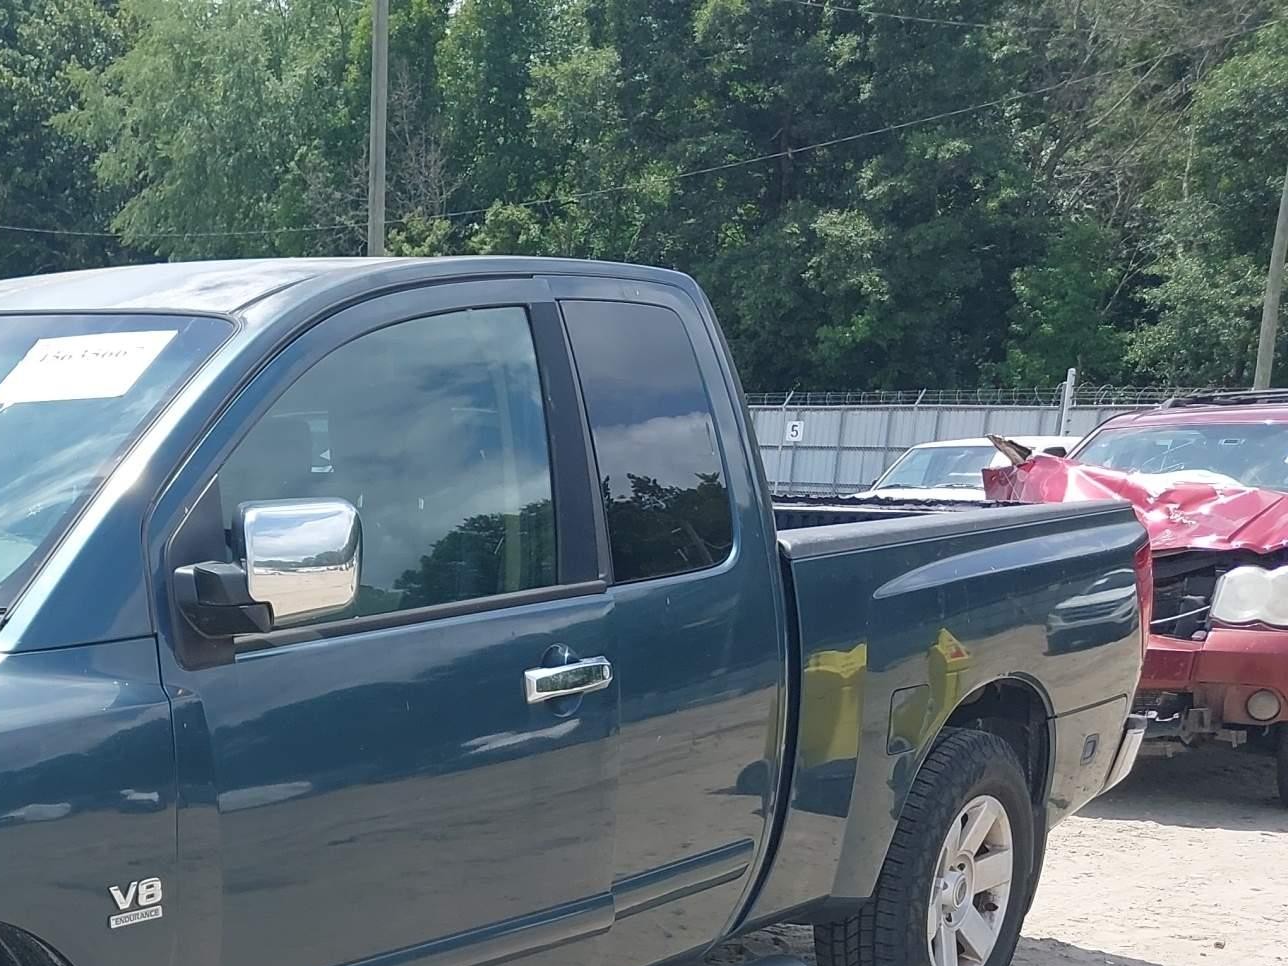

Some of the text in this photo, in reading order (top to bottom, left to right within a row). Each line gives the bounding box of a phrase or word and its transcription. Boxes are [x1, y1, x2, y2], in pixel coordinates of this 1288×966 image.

[790, 424, 799, 438] 5
[109, 877, 162, 910] V8
[114, 908, 160, 925] ENDURANCE
